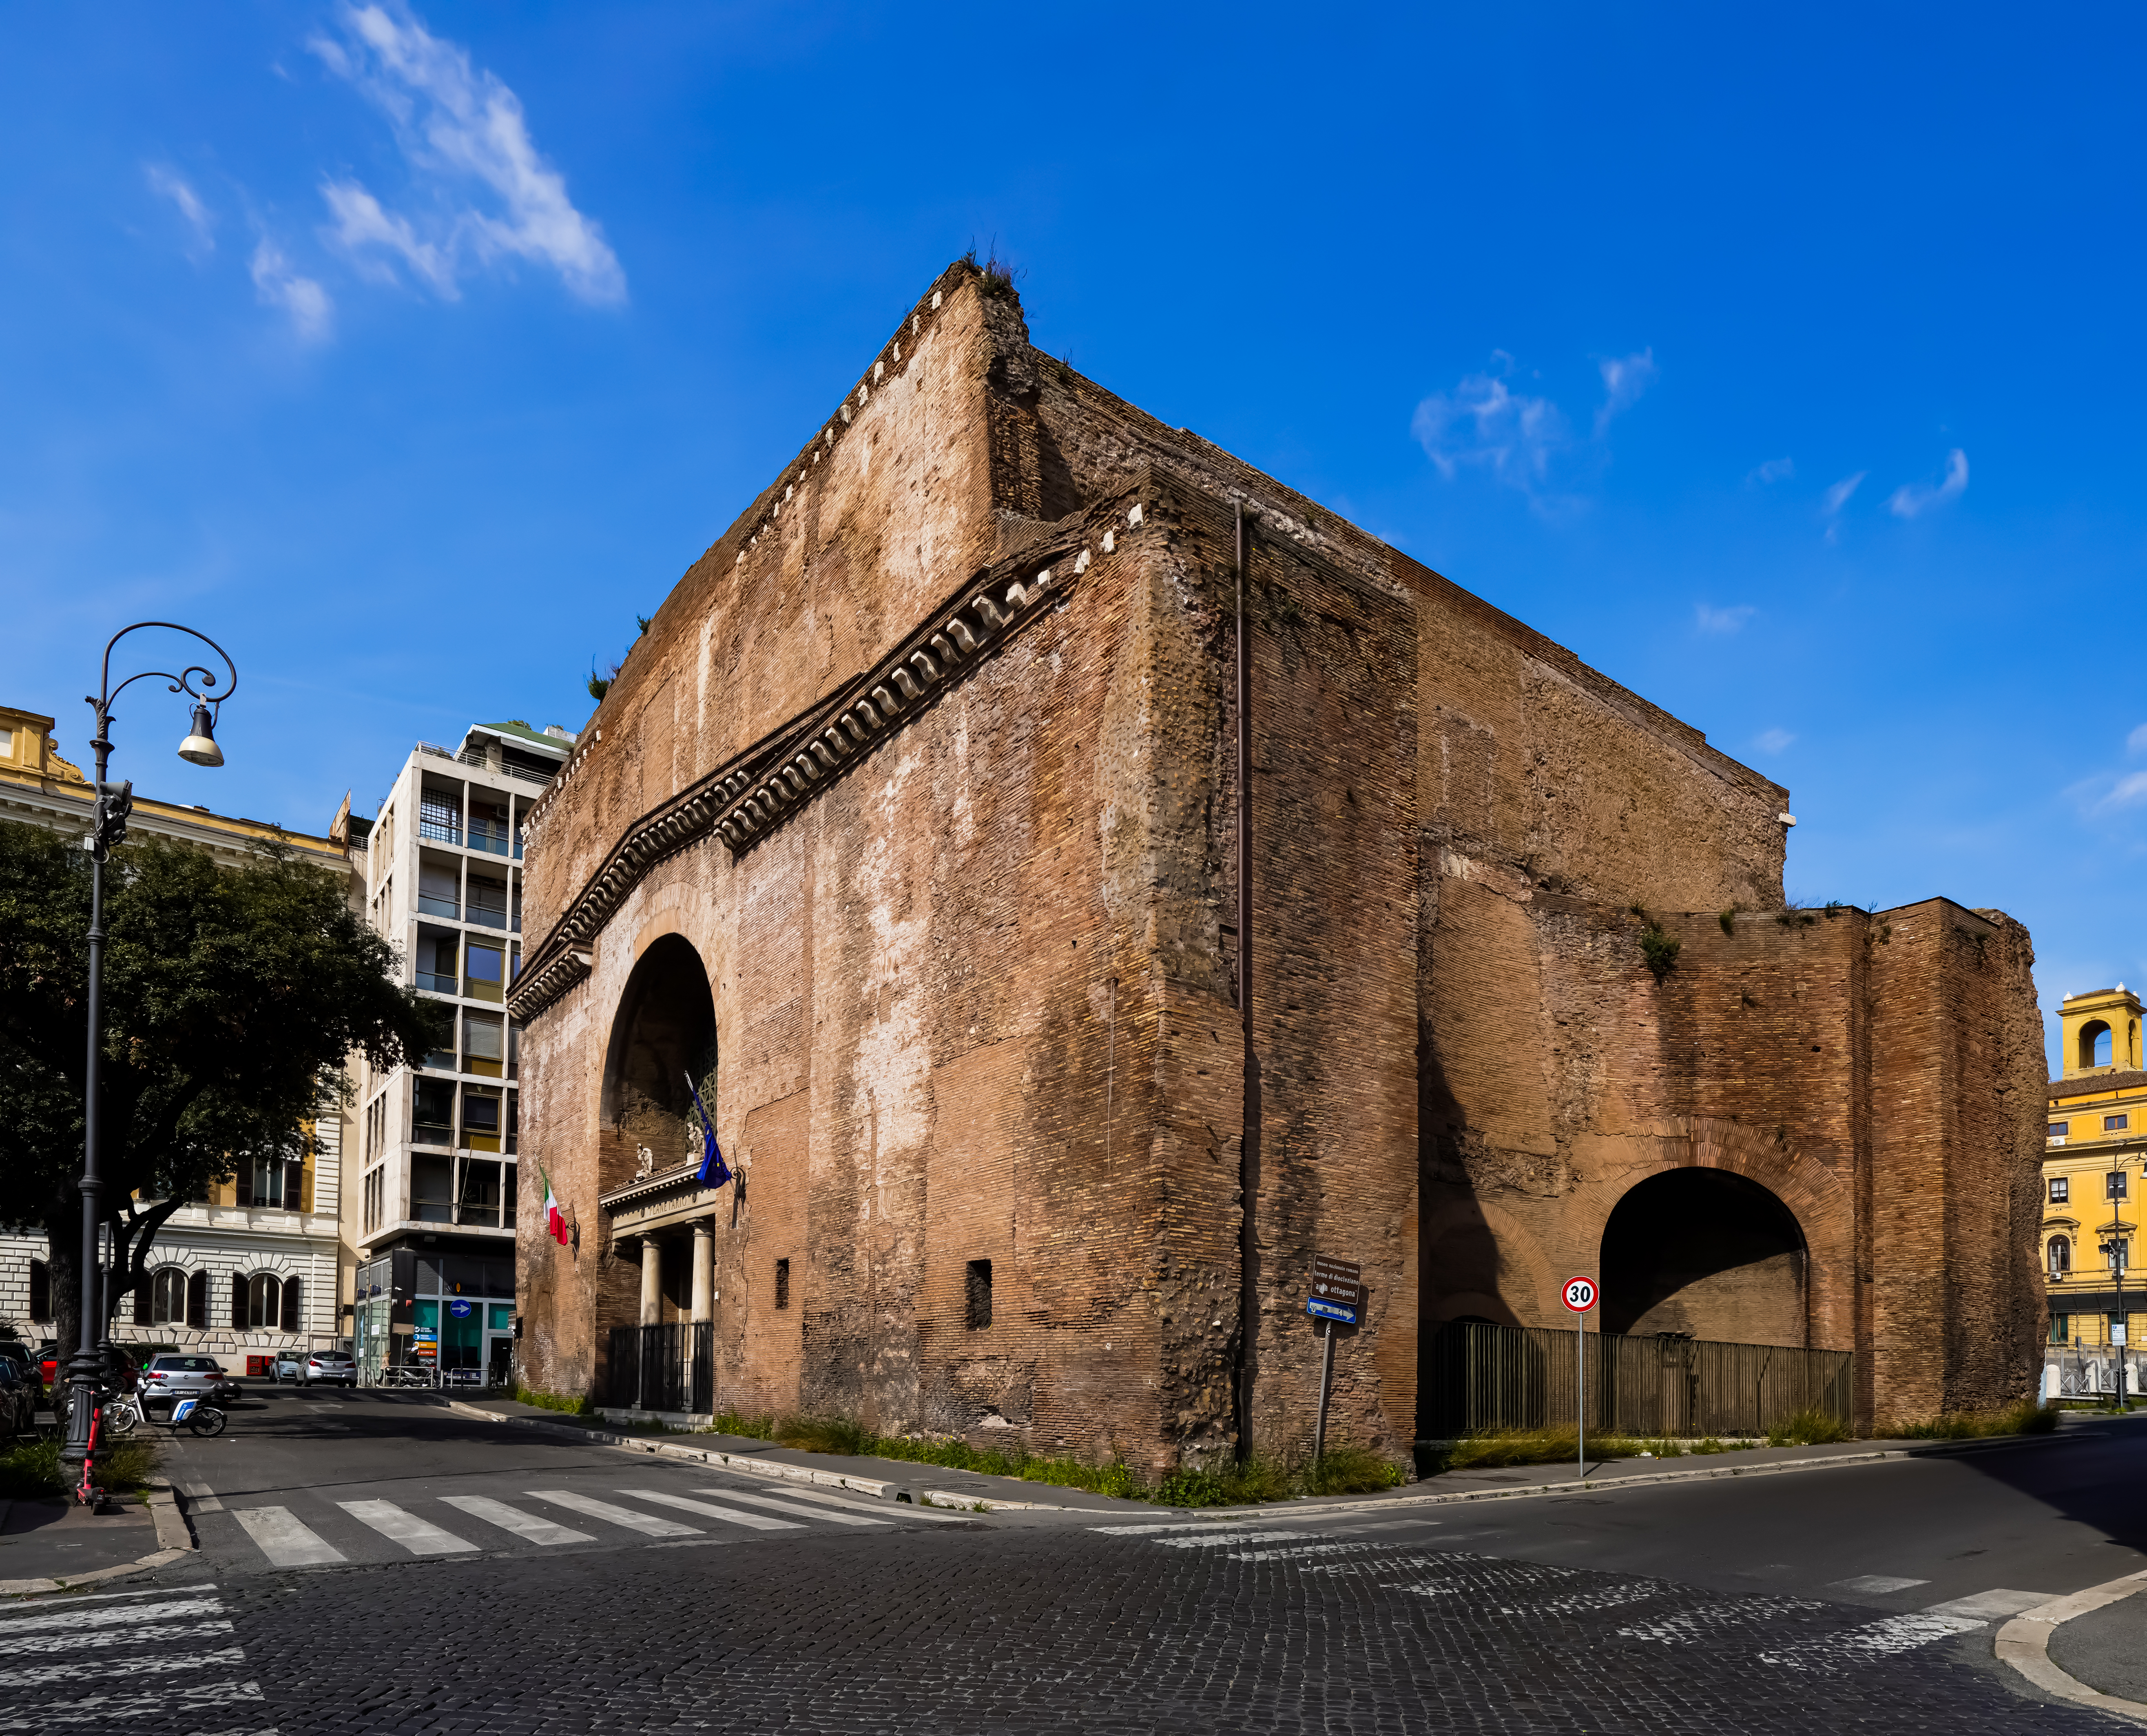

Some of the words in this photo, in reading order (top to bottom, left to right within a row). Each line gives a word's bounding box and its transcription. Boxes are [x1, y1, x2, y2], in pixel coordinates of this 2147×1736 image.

[650, 1196, 687, 1216] PLANETARIO
[1315, 1270, 1328, 1278] terme
[1334, 1274, 1359, 1285] diocleziano
[1569, 1285, 1591, 1302] 30
